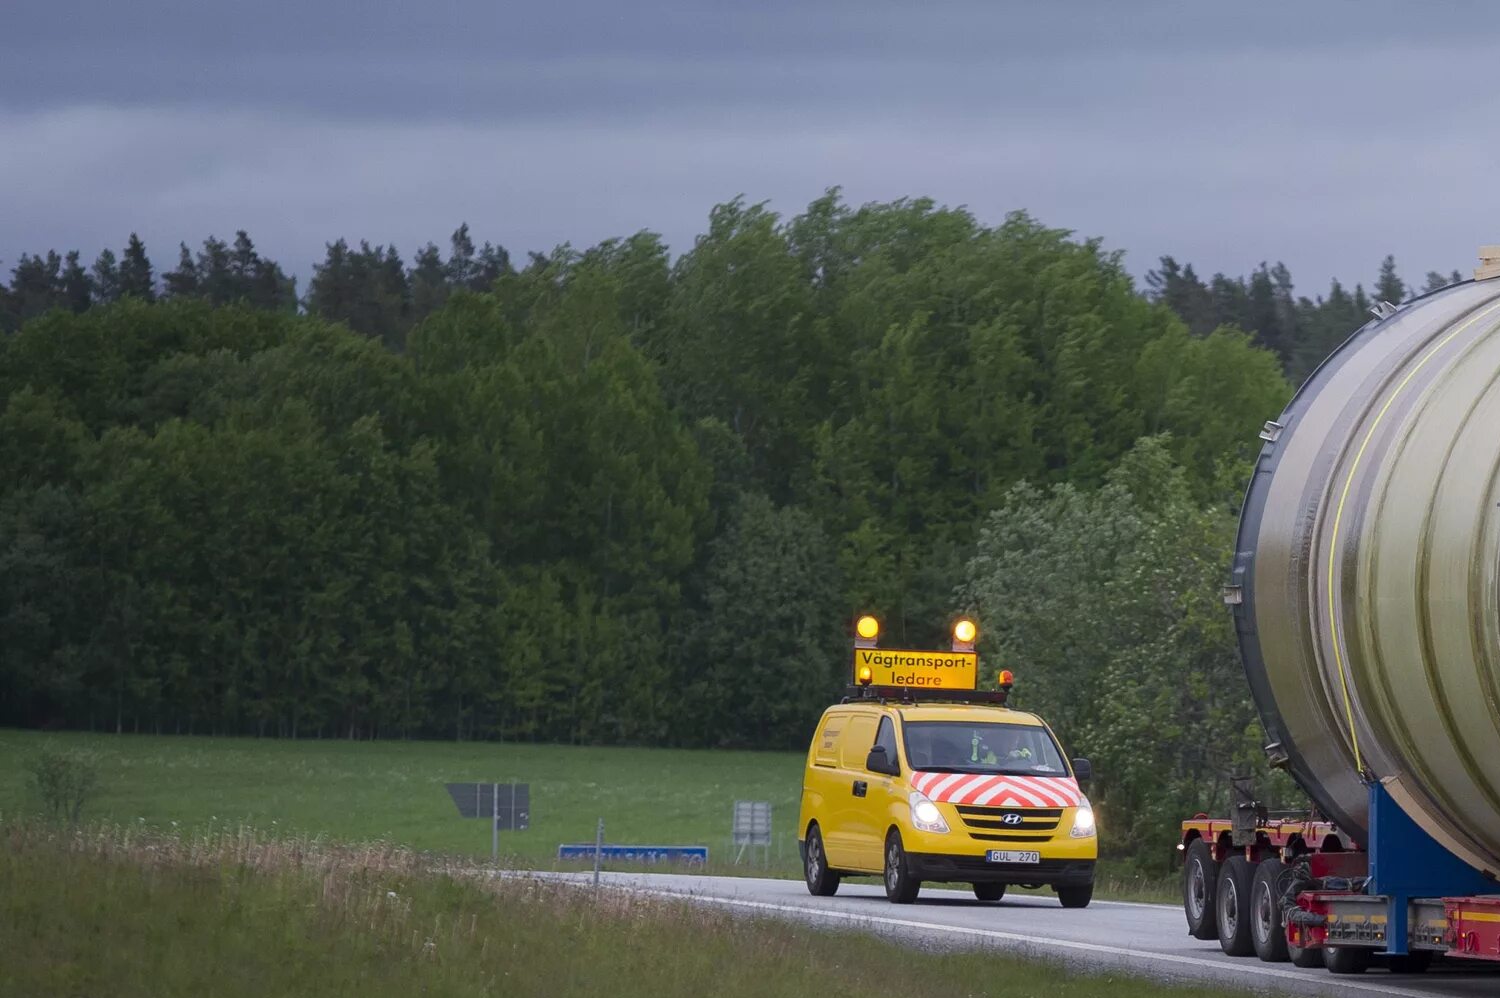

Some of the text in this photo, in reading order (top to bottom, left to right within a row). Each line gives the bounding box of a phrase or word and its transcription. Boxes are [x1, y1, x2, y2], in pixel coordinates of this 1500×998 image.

[862, 651, 972, 670] Vägtransport-
[891, 671, 942, 686] ledare
[993, 851, 1038, 862] GUL 270
